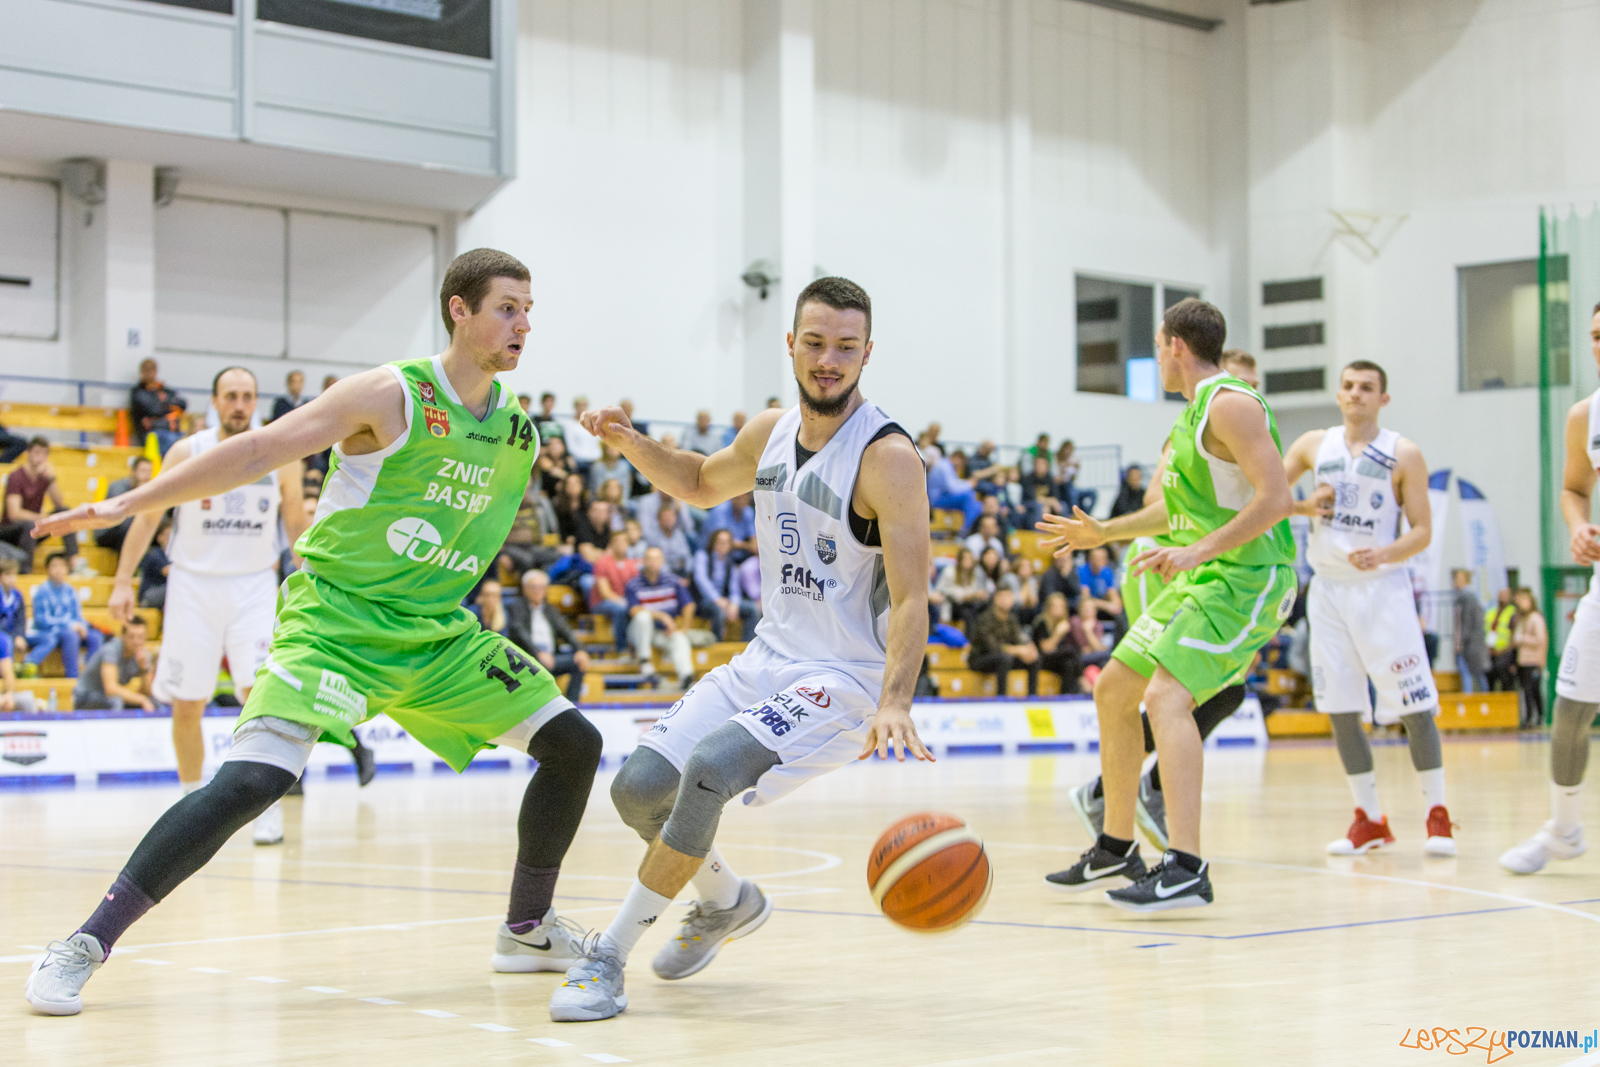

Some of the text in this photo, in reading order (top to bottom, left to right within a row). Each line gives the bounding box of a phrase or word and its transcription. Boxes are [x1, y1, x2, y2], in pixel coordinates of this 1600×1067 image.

[506, 413, 533, 451] 14
[423, 482, 492, 514] BASKET
[776, 512, 800, 556] 6
[1168, 513, 1197, 531] NIA
[406, 539, 479, 576] UNIA
[486, 646, 541, 694] 14
[752, 704, 791, 737] PBG
